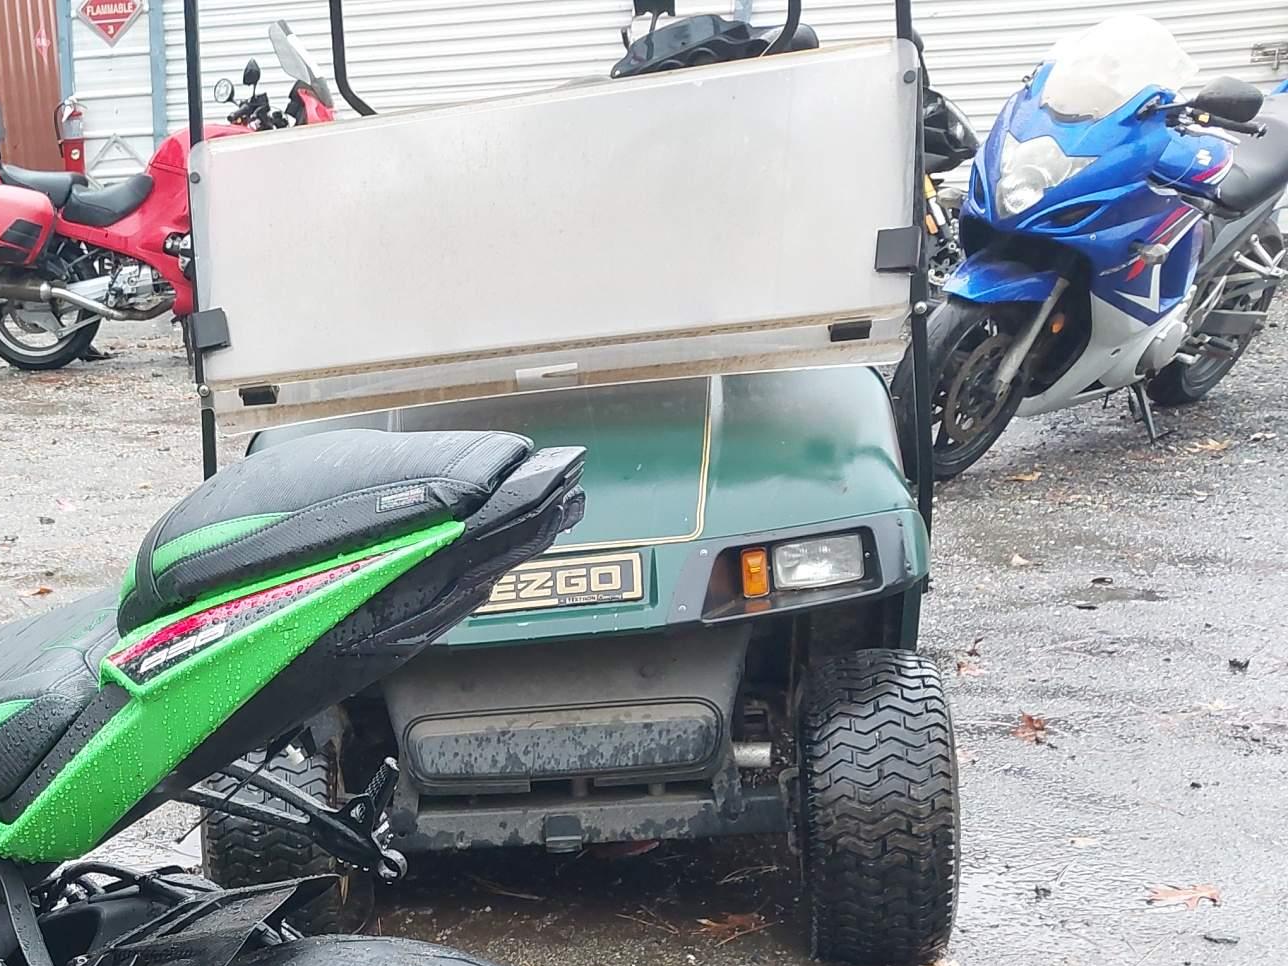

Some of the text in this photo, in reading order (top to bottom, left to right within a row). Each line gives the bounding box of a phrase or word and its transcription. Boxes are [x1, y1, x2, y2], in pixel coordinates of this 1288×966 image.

[86, 3, 133, 16] FLAMMABLE
[107, 25, 114, 34] 3
[489, 564, 621, 602] EZGO
